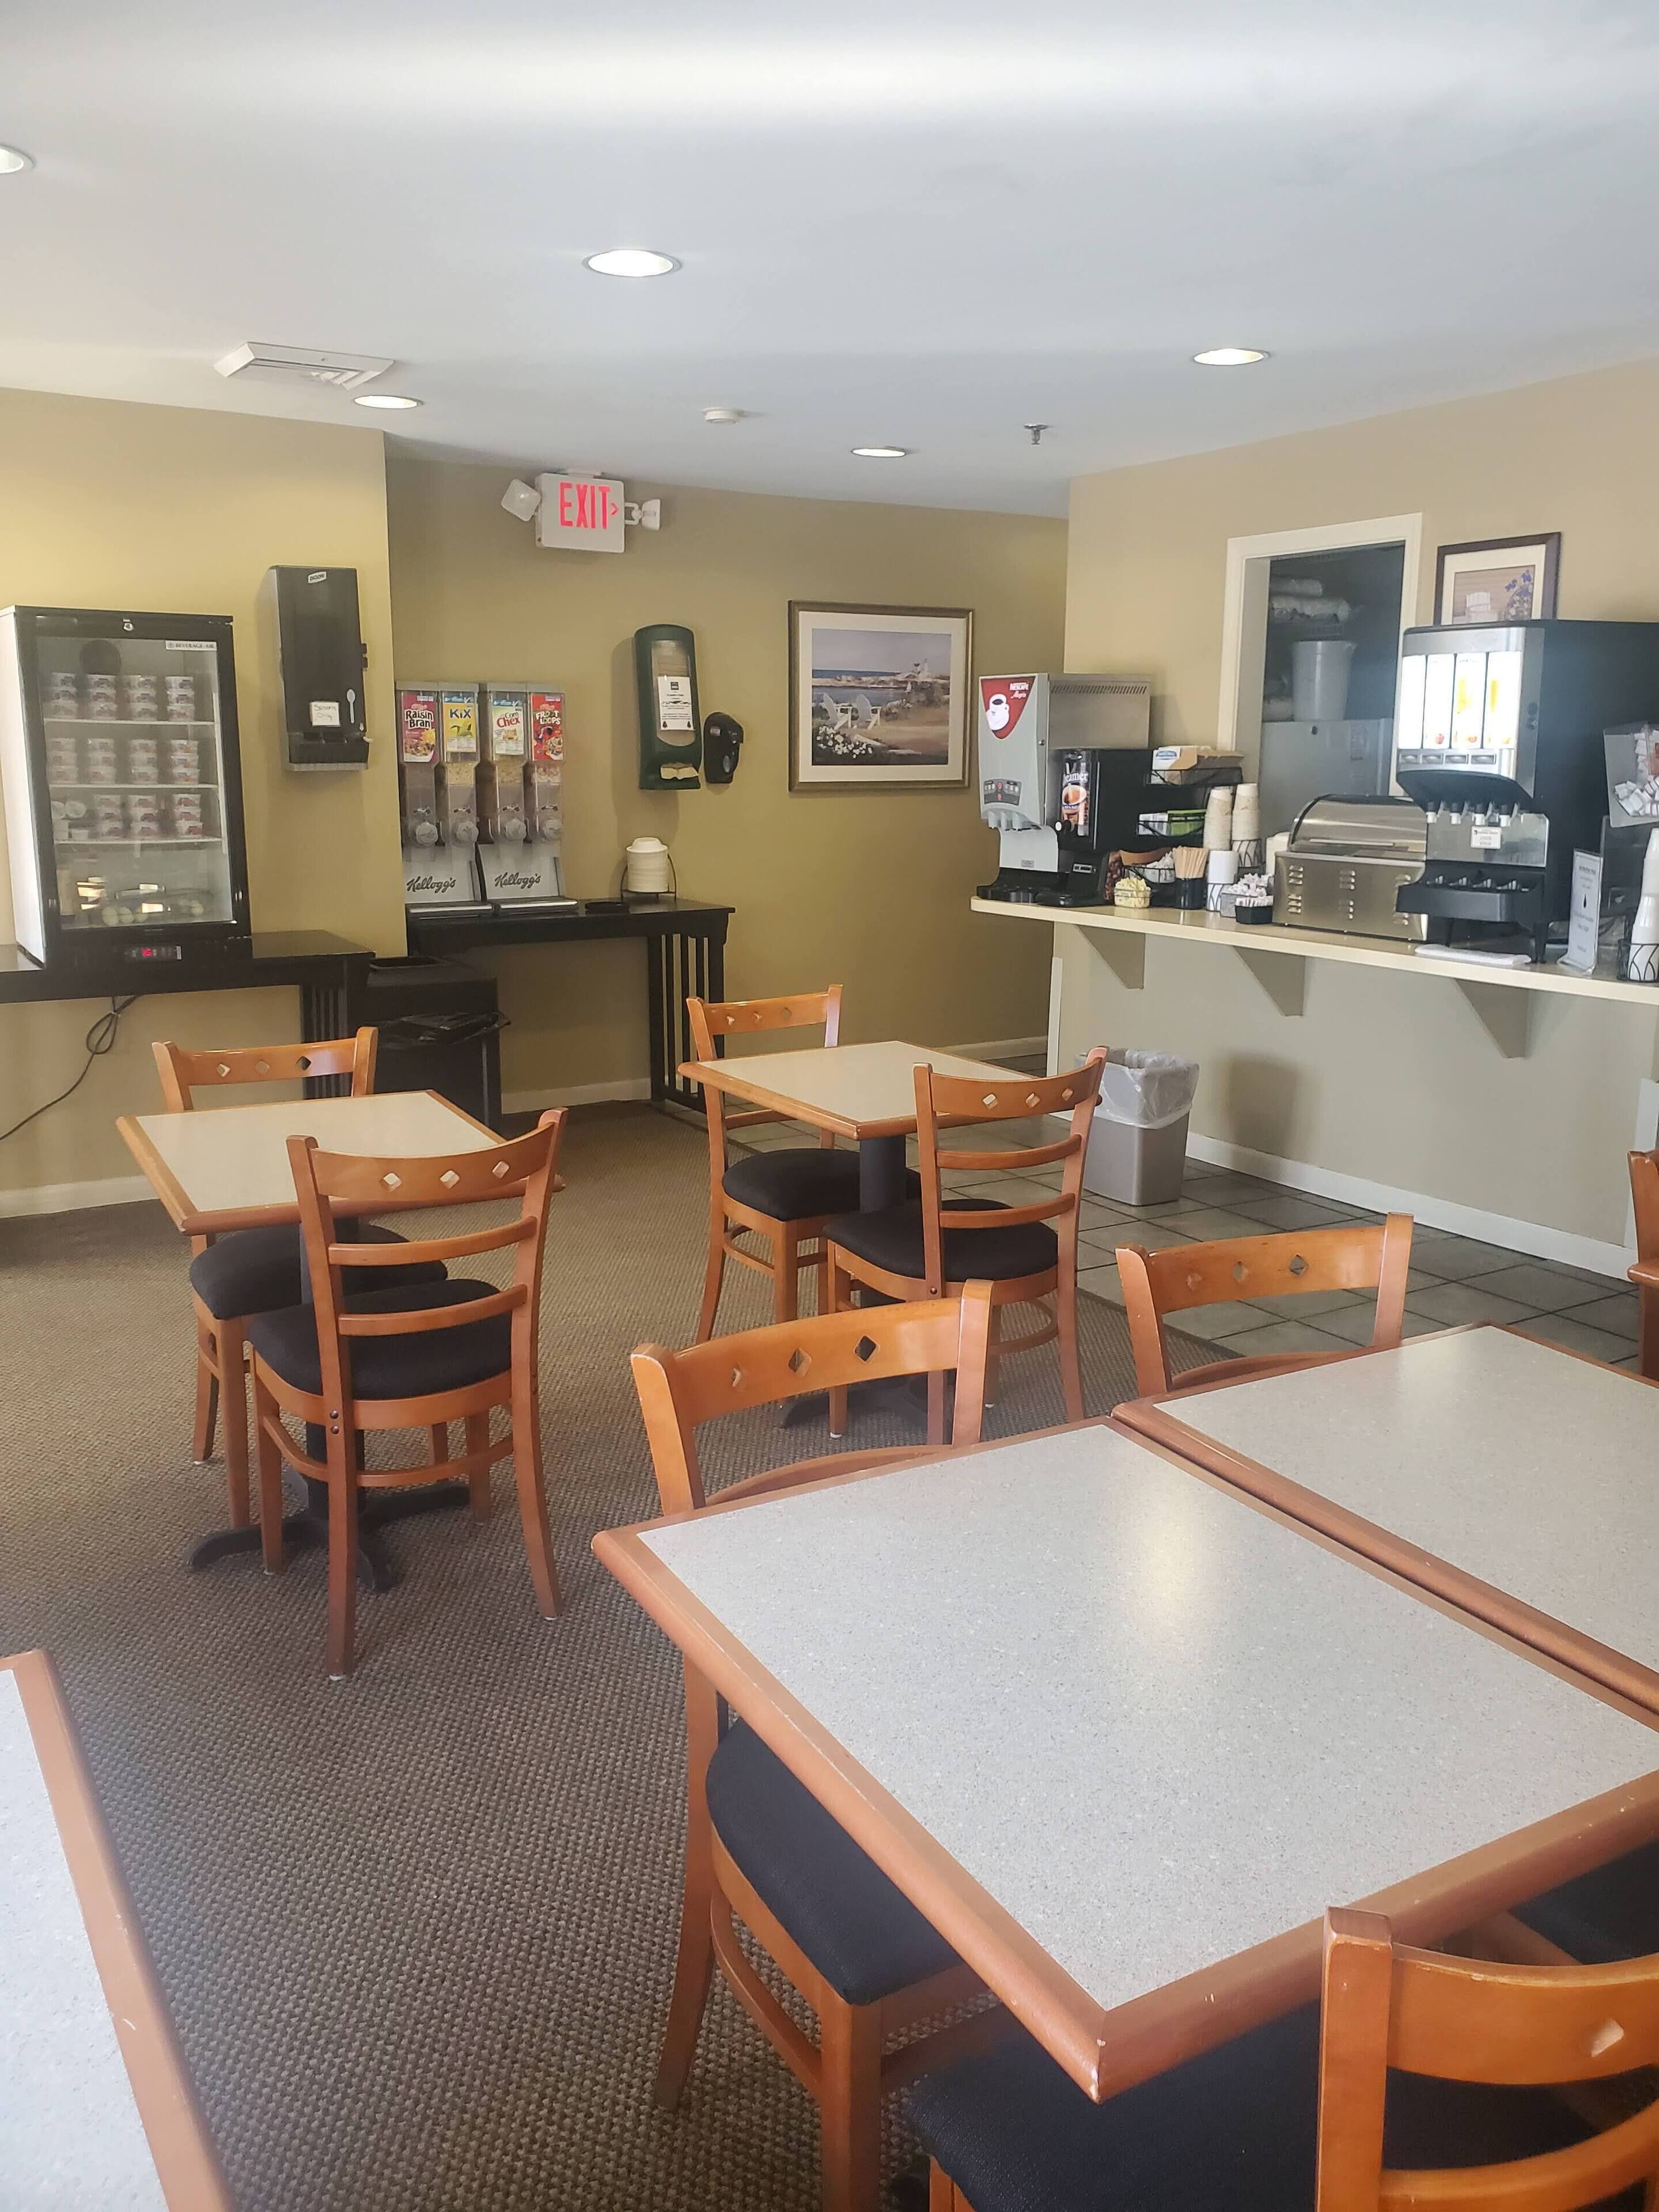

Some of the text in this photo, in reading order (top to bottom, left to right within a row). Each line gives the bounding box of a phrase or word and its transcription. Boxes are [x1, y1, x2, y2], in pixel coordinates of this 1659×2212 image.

[560, 482, 611, 529] EXIT
[405, 709, 433, 721] Raisin
[497, 716, 520, 728] Chex
[409, 718, 431, 729] Bran
[407, 876, 457, 893] Kellogg's
[494, 872, 541, 889] Kellogg's
